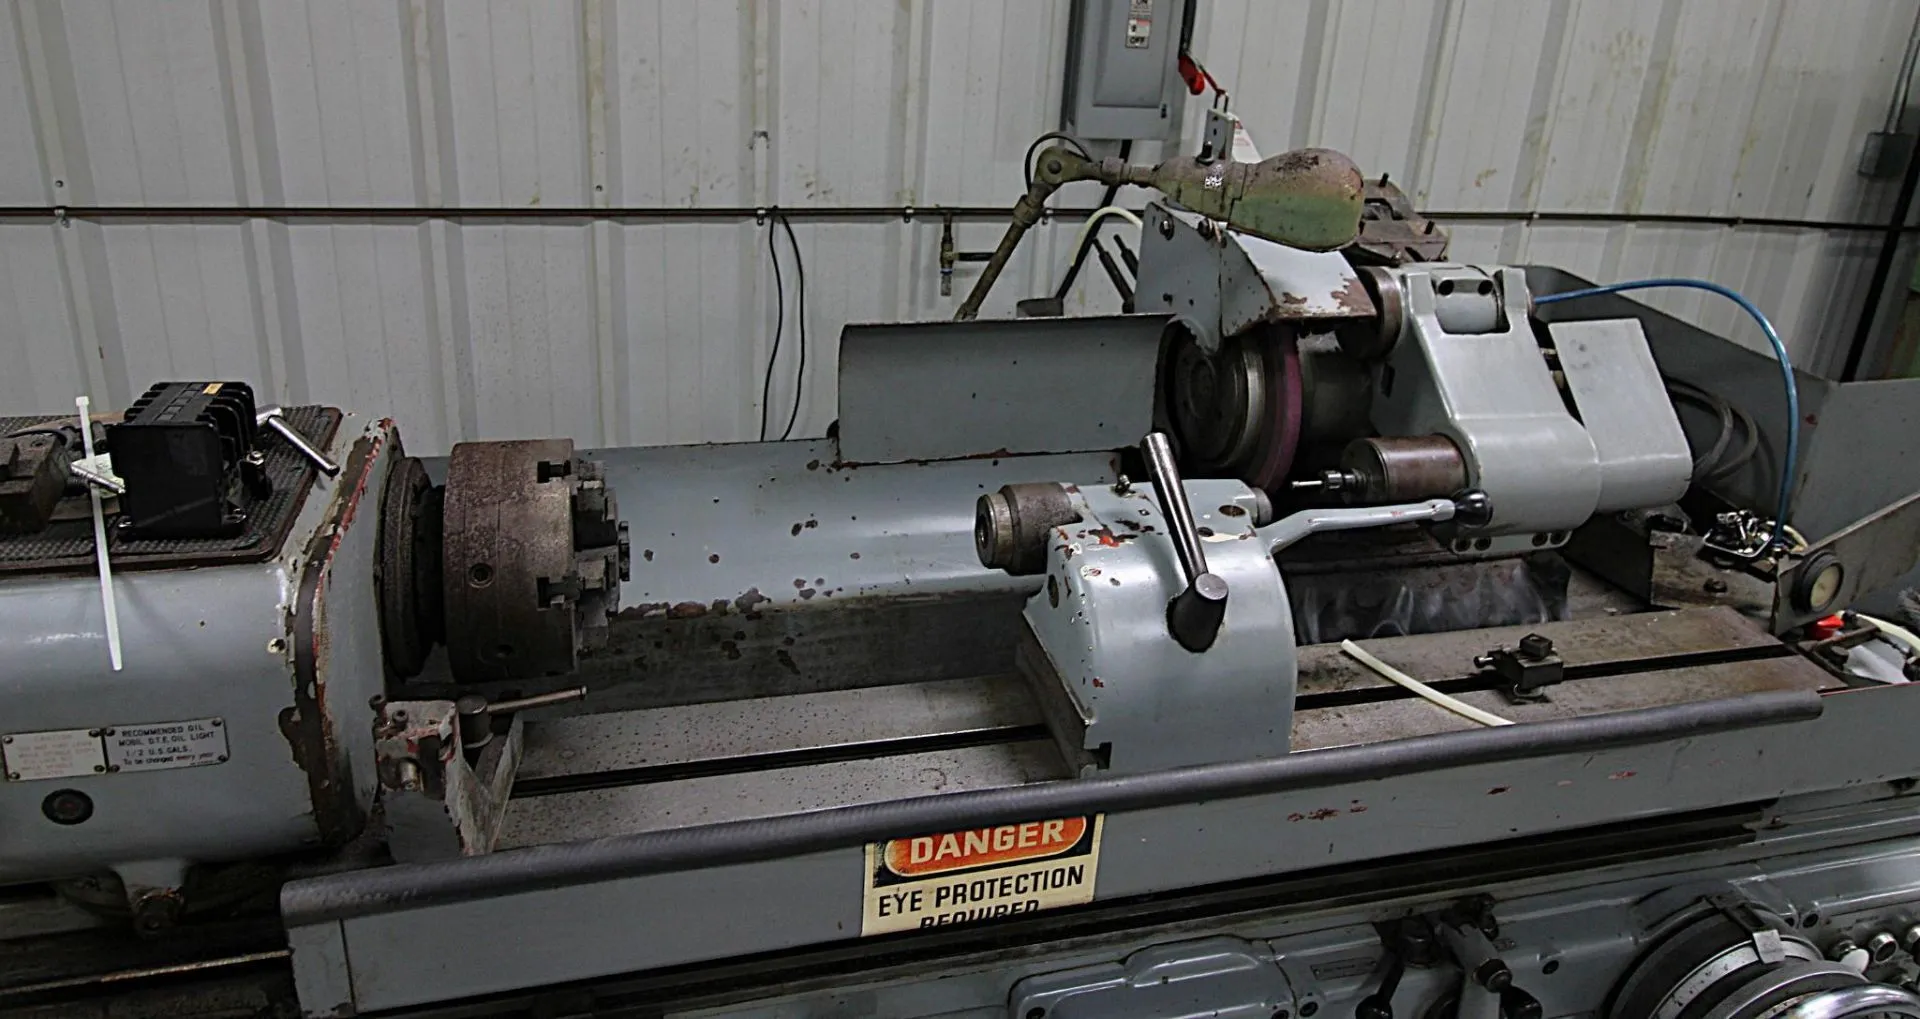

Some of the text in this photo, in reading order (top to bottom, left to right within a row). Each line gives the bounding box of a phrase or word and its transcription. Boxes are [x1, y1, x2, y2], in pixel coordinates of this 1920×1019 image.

[1129, 36, 1145, 44] OFF
[122, 724, 204, 737] RECOMMENDED OIL
[118, 739, 144, 747] MOBIL
[190, 731, 214, 741] LIGHT
[146, 756, 174, 764] changed
[910, 819, 1065, 865] DANGER
[879, 864, 1084, 917] EYE PROTECTION
